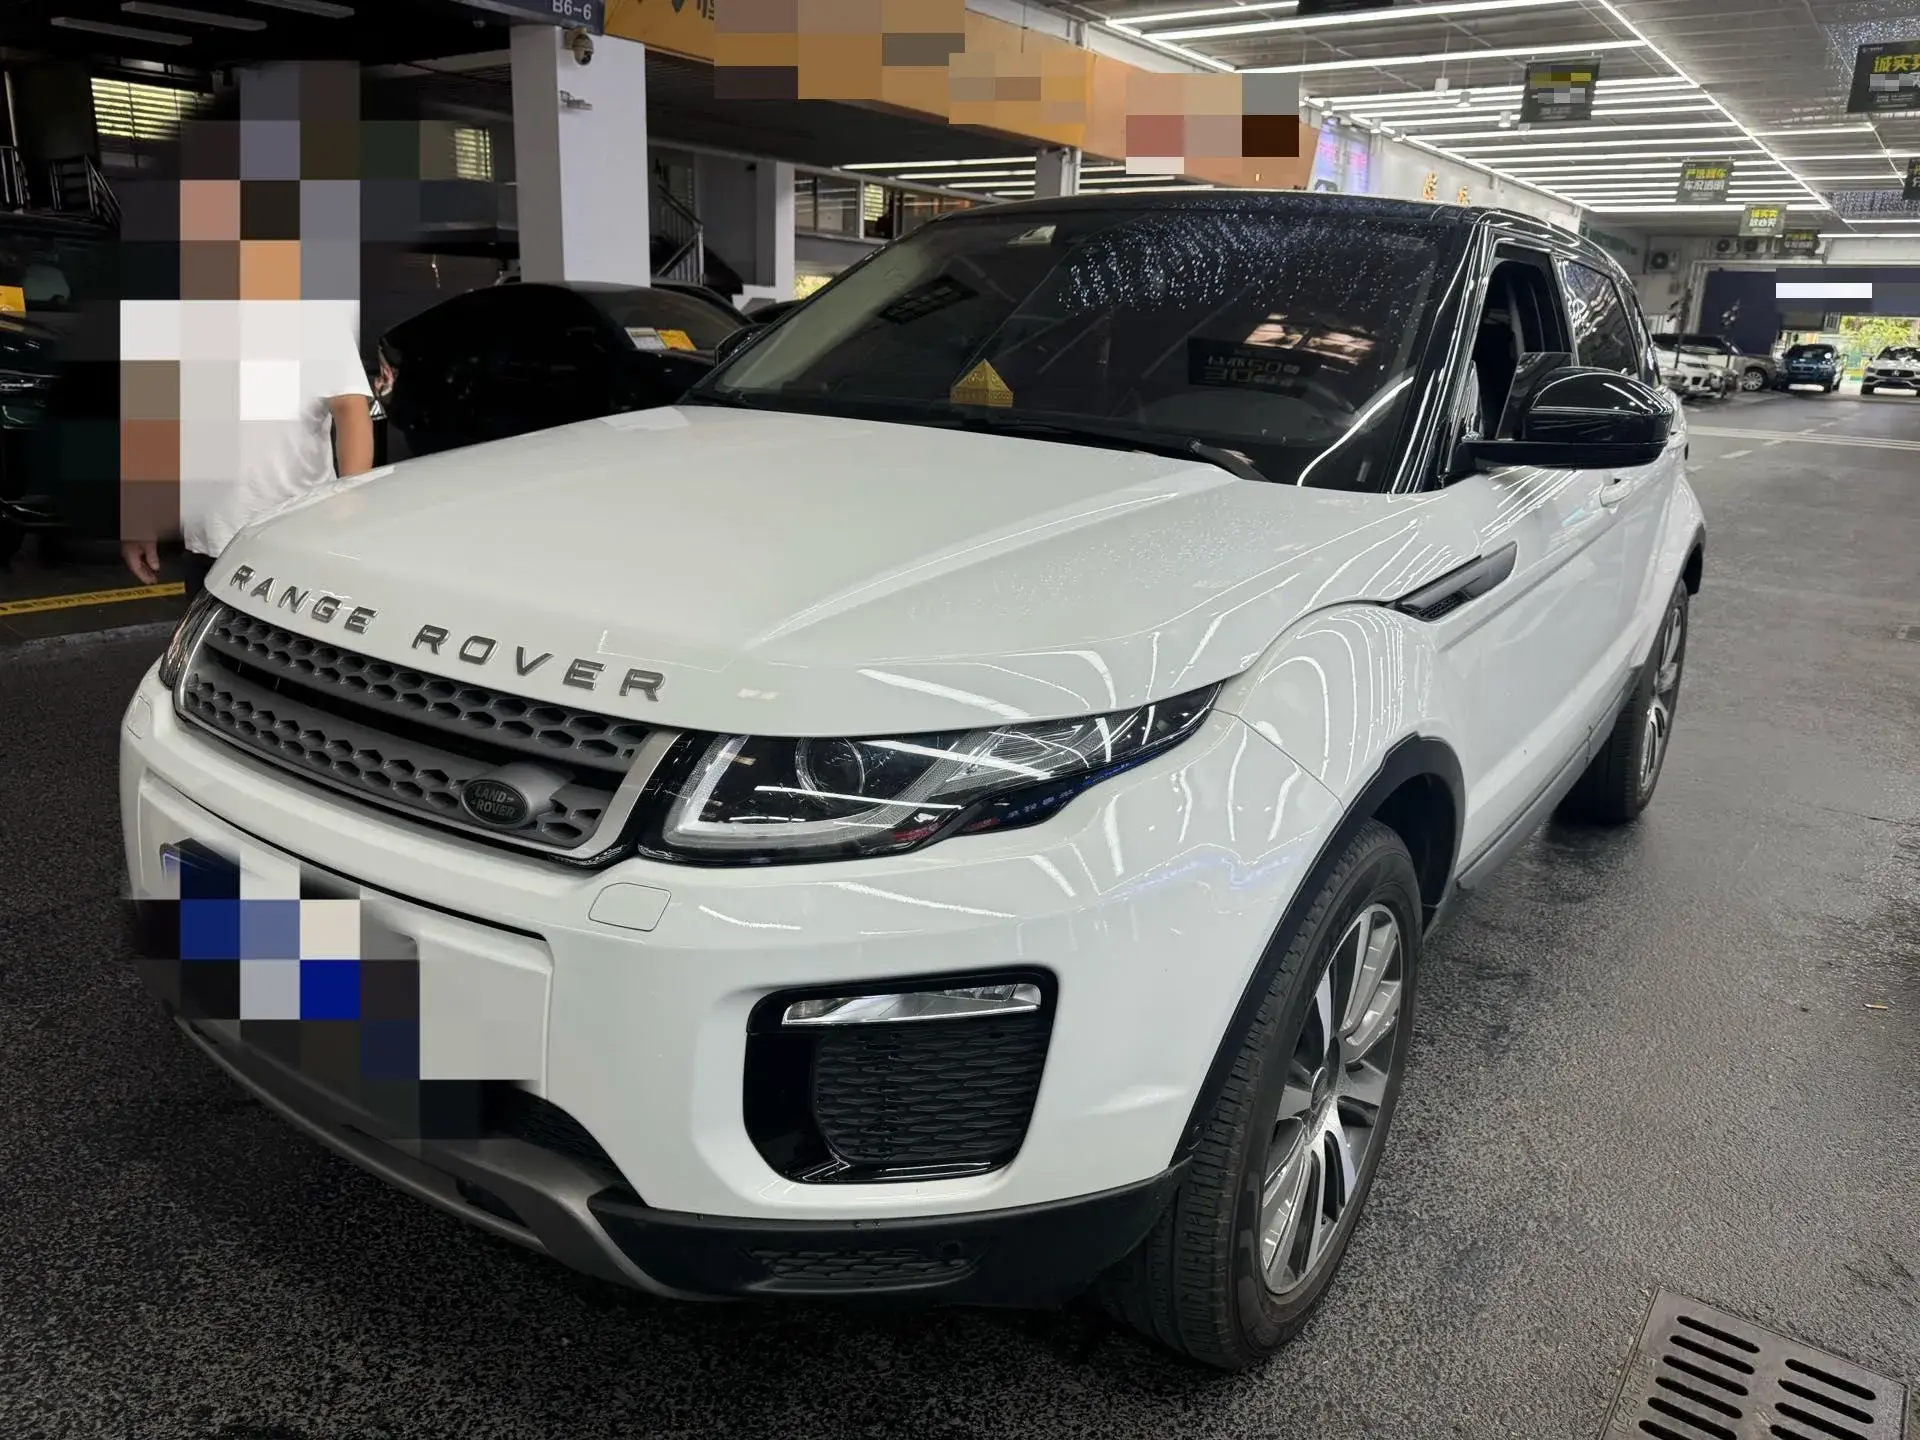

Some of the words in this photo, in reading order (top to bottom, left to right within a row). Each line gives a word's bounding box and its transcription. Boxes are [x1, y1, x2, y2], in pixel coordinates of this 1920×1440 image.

[552, 0, 592, 20] B6-6
[229, 564, 379, 634] RANGE
[411, 623, 666, 703] ROVER
